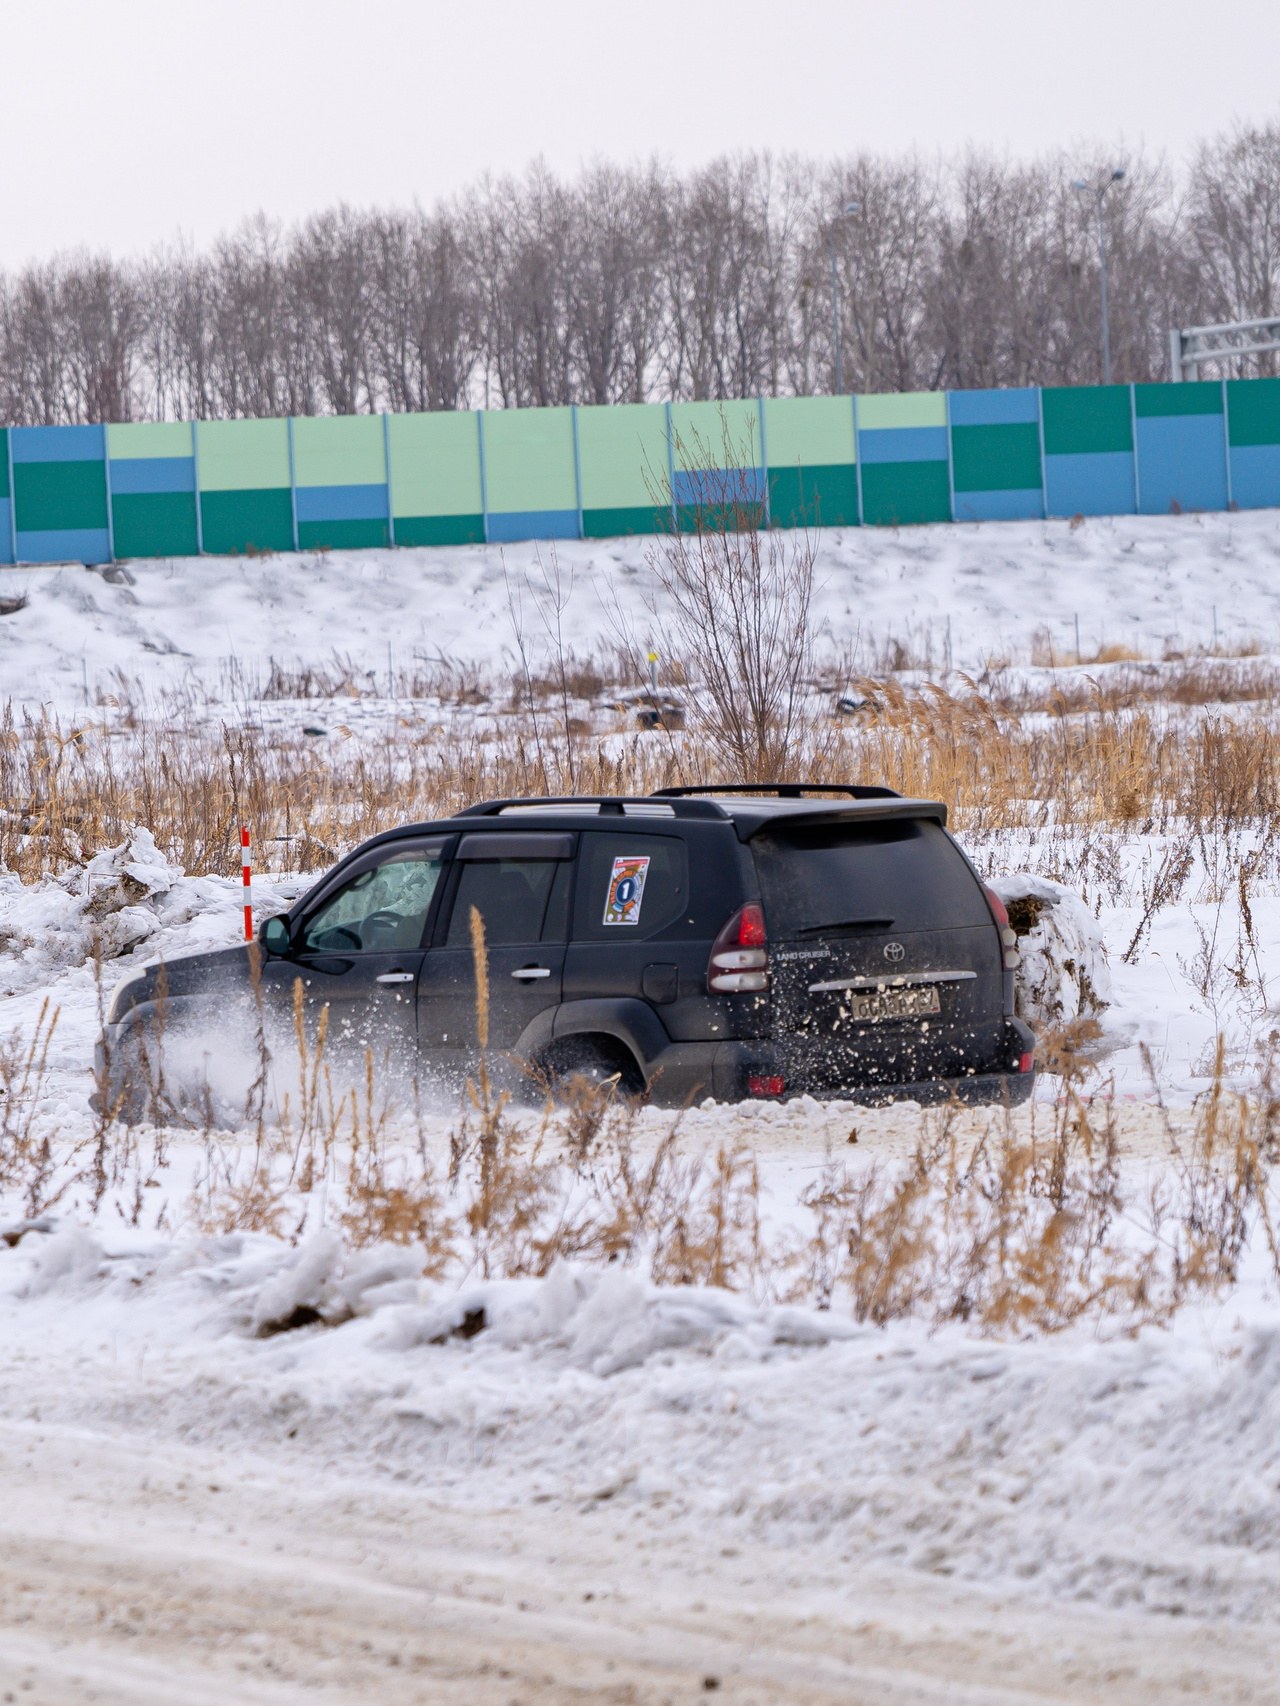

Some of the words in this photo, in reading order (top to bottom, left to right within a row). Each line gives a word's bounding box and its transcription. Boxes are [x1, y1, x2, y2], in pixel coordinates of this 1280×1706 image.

[622, 881, 631, 900] 1
[776, 952, 798, 961] LAND
[798, 950, 831, 959] CRUISER
